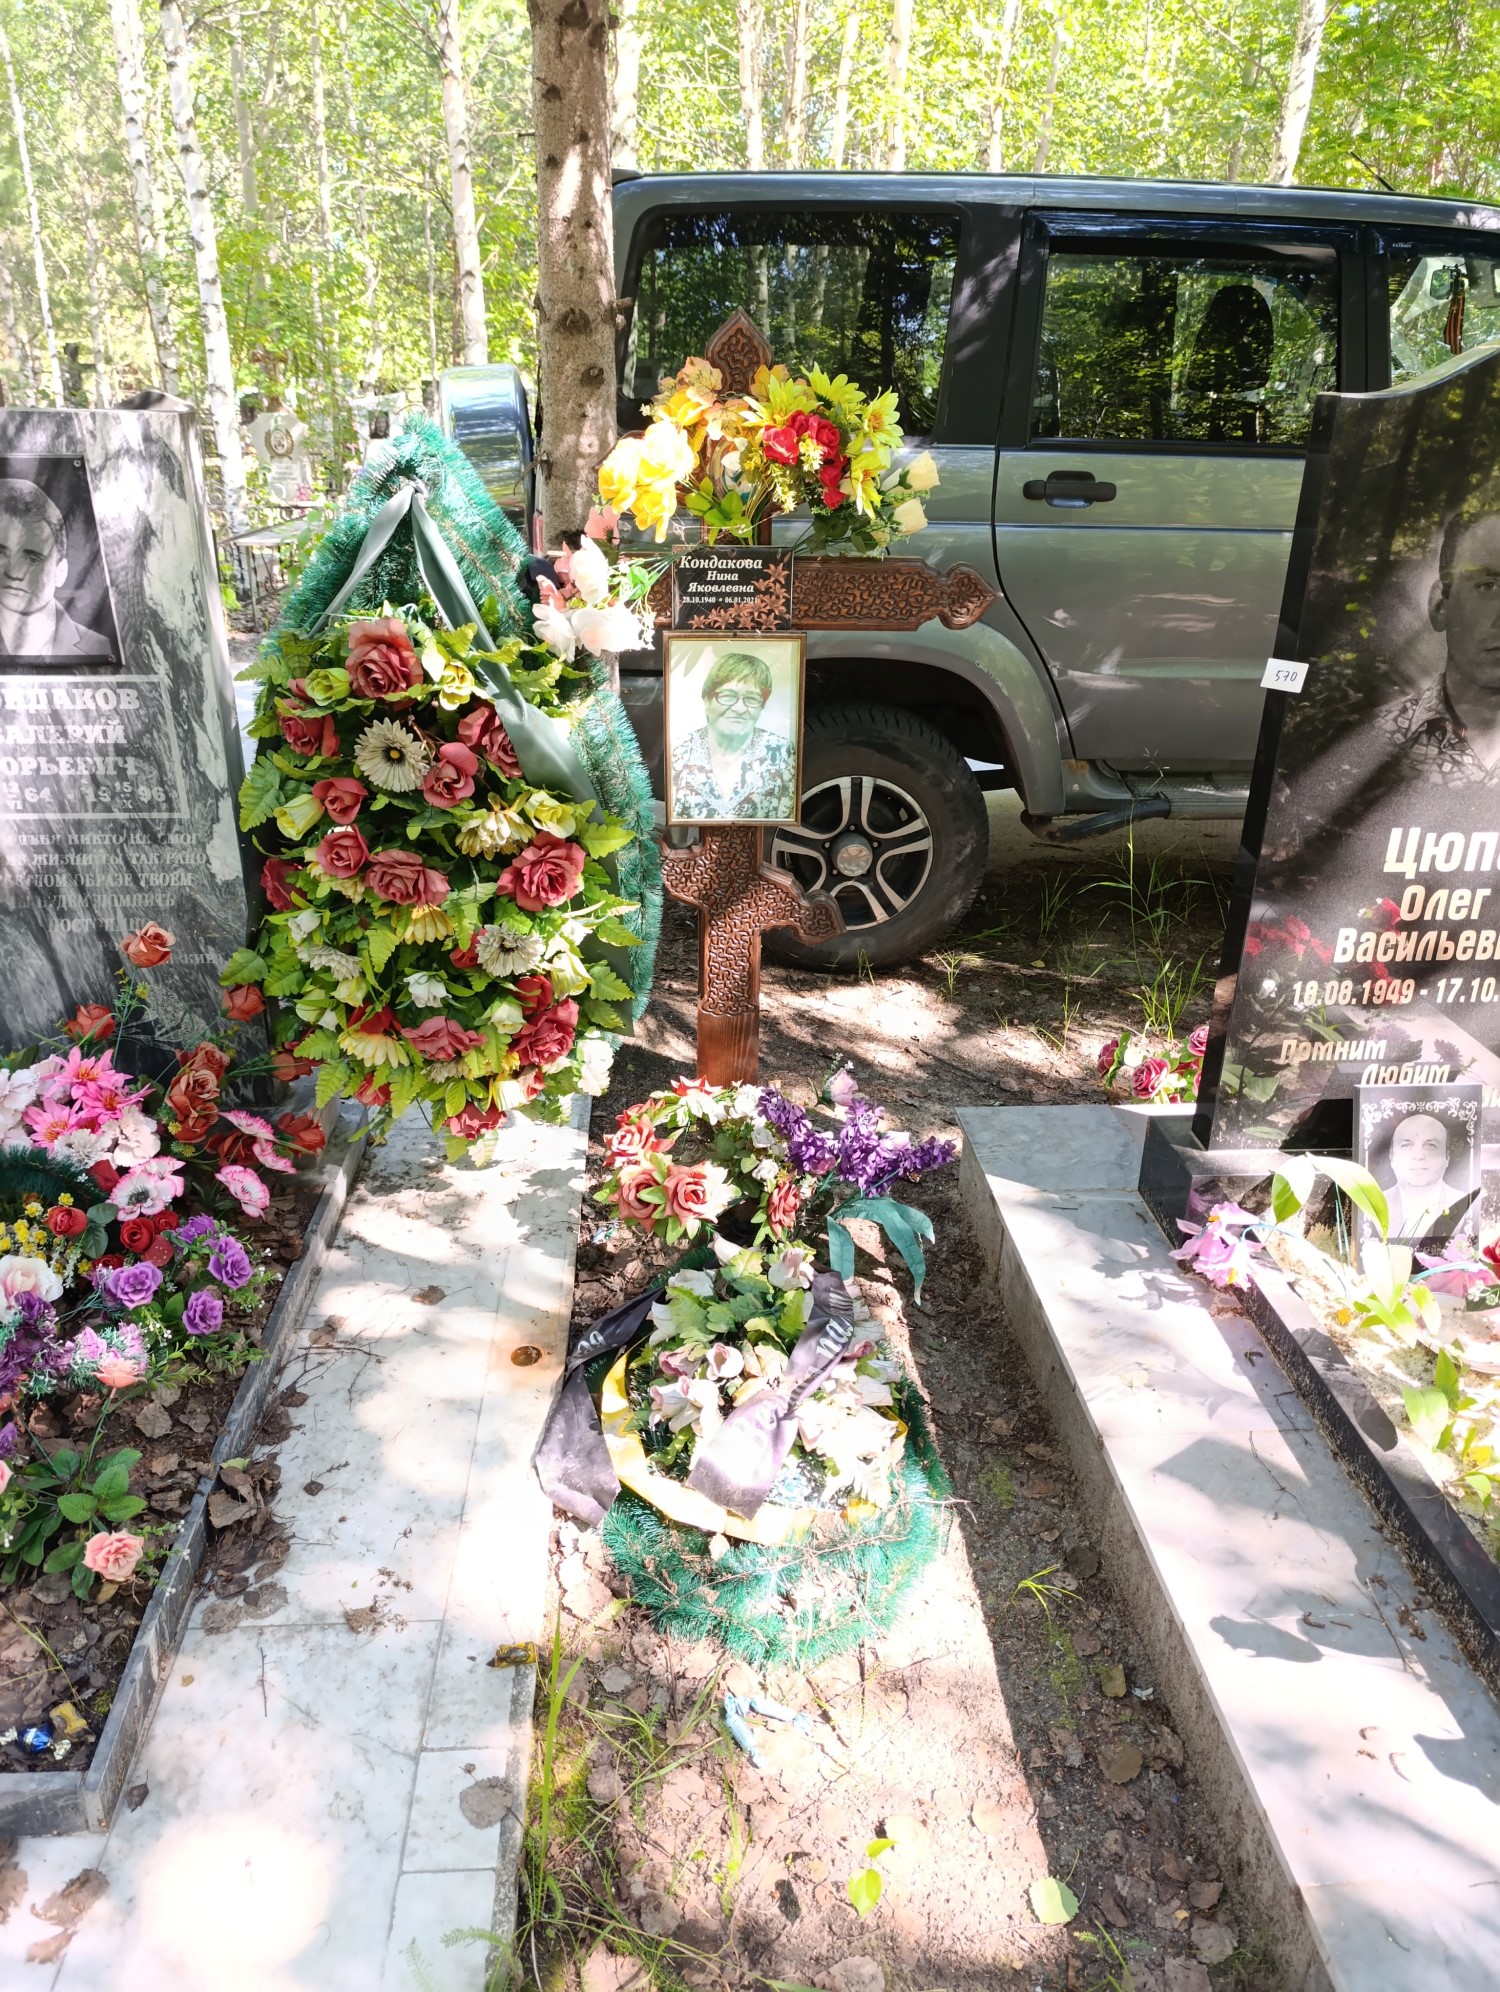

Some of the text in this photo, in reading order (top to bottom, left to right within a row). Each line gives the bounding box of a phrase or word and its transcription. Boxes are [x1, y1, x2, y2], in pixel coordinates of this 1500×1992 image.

[679, 555, 763, 569] Кондакова
[687, 582, 754, 593] Яковлевна
[706, 571, 739, 581] Нина
[0, 688, 140, 713] НДАКОВ
[0, 719, 128, 744] АЛЕРИЙ
[1383, 827, 1500, 879] ЦЮП
[139, 873, 193, 886] ТВОЕМ
[1400, 885, 1492, 921] Олег
[1333, 927, 1500, 963] Васильев
[1292, 979, 1415, 1005] 18.08.1949
[1280, 1039, 1387, 1061] Помним
[1360, 1063, 1451, 1085] Любим
